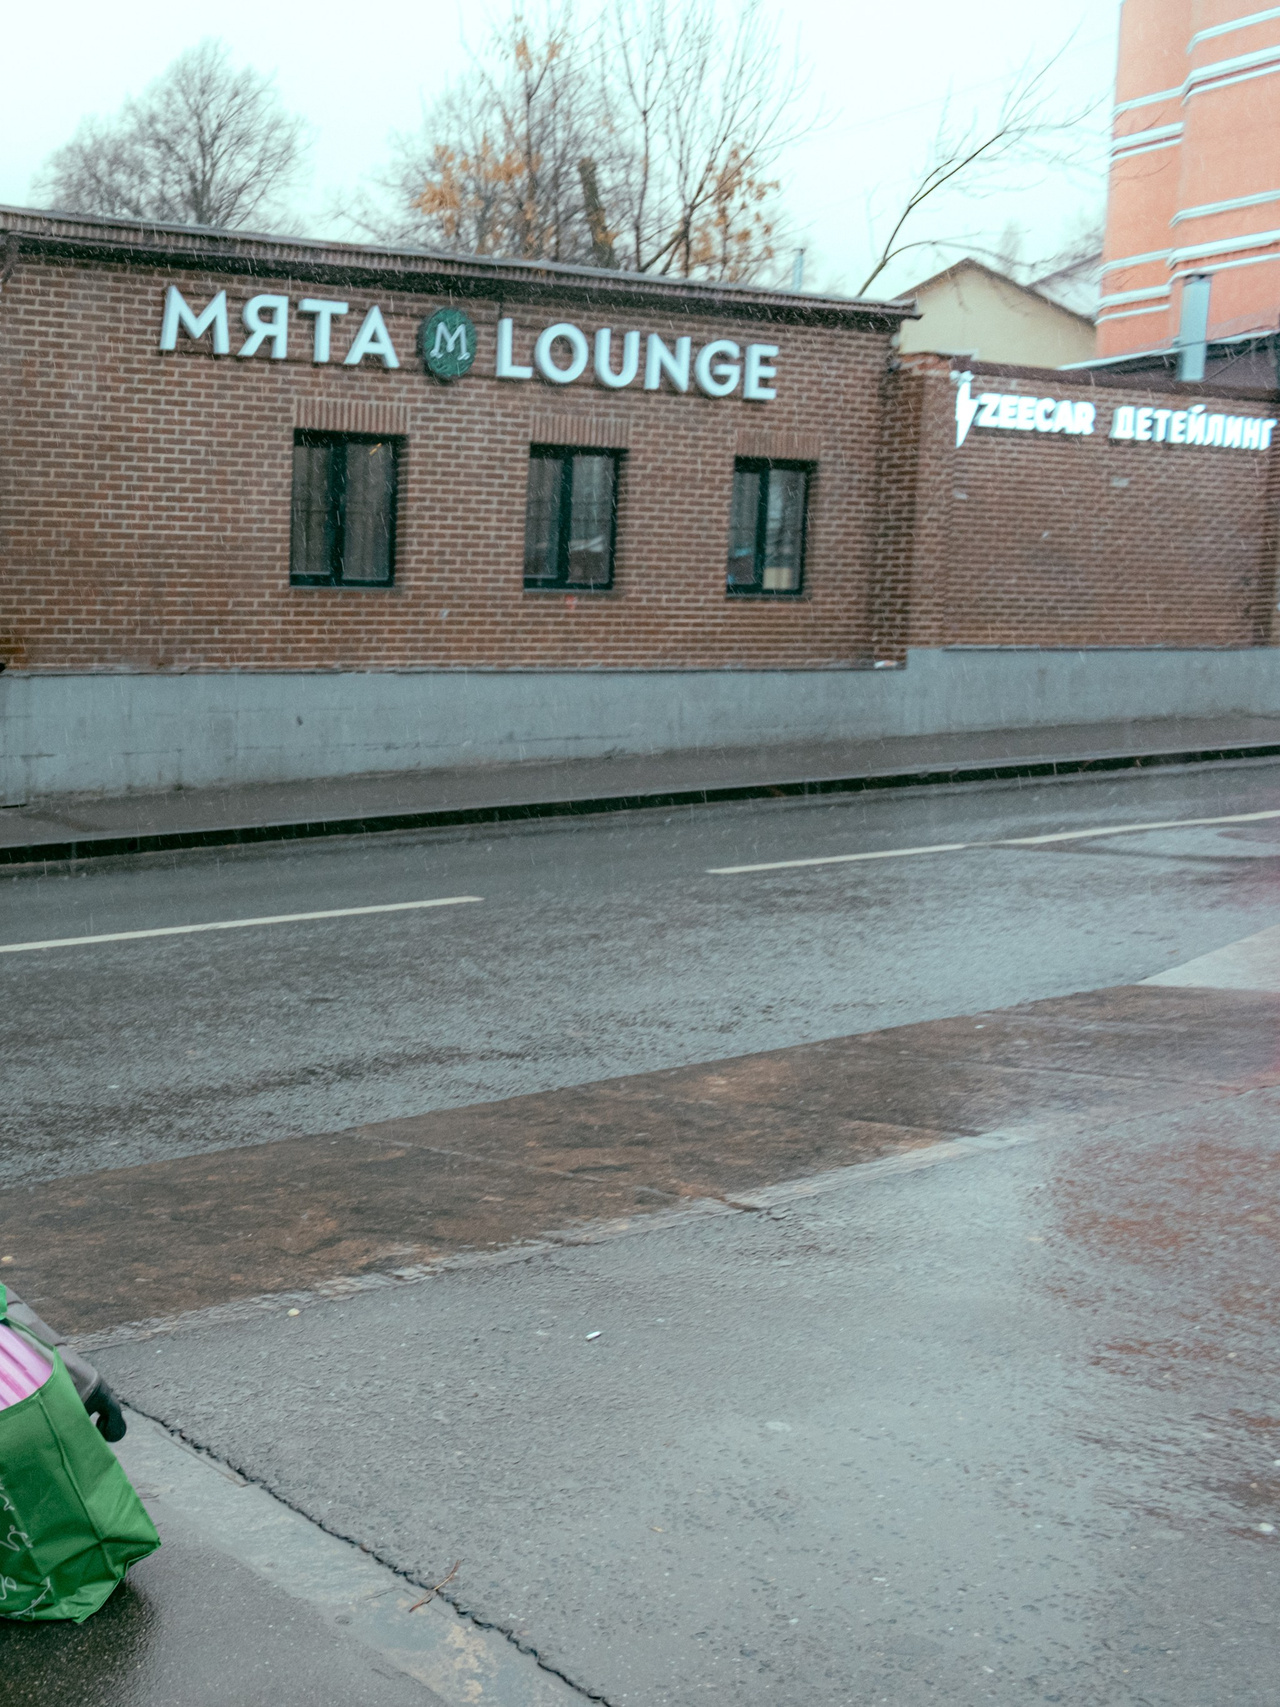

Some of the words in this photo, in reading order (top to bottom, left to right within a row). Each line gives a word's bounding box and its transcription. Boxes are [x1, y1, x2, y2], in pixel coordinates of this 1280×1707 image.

[159, 284, 400, 369] МЯТА
[495, 317, 780, 400] LOUNGE
[1109, 404, 1278, 450] ДЕТЕЙЛИНГ
